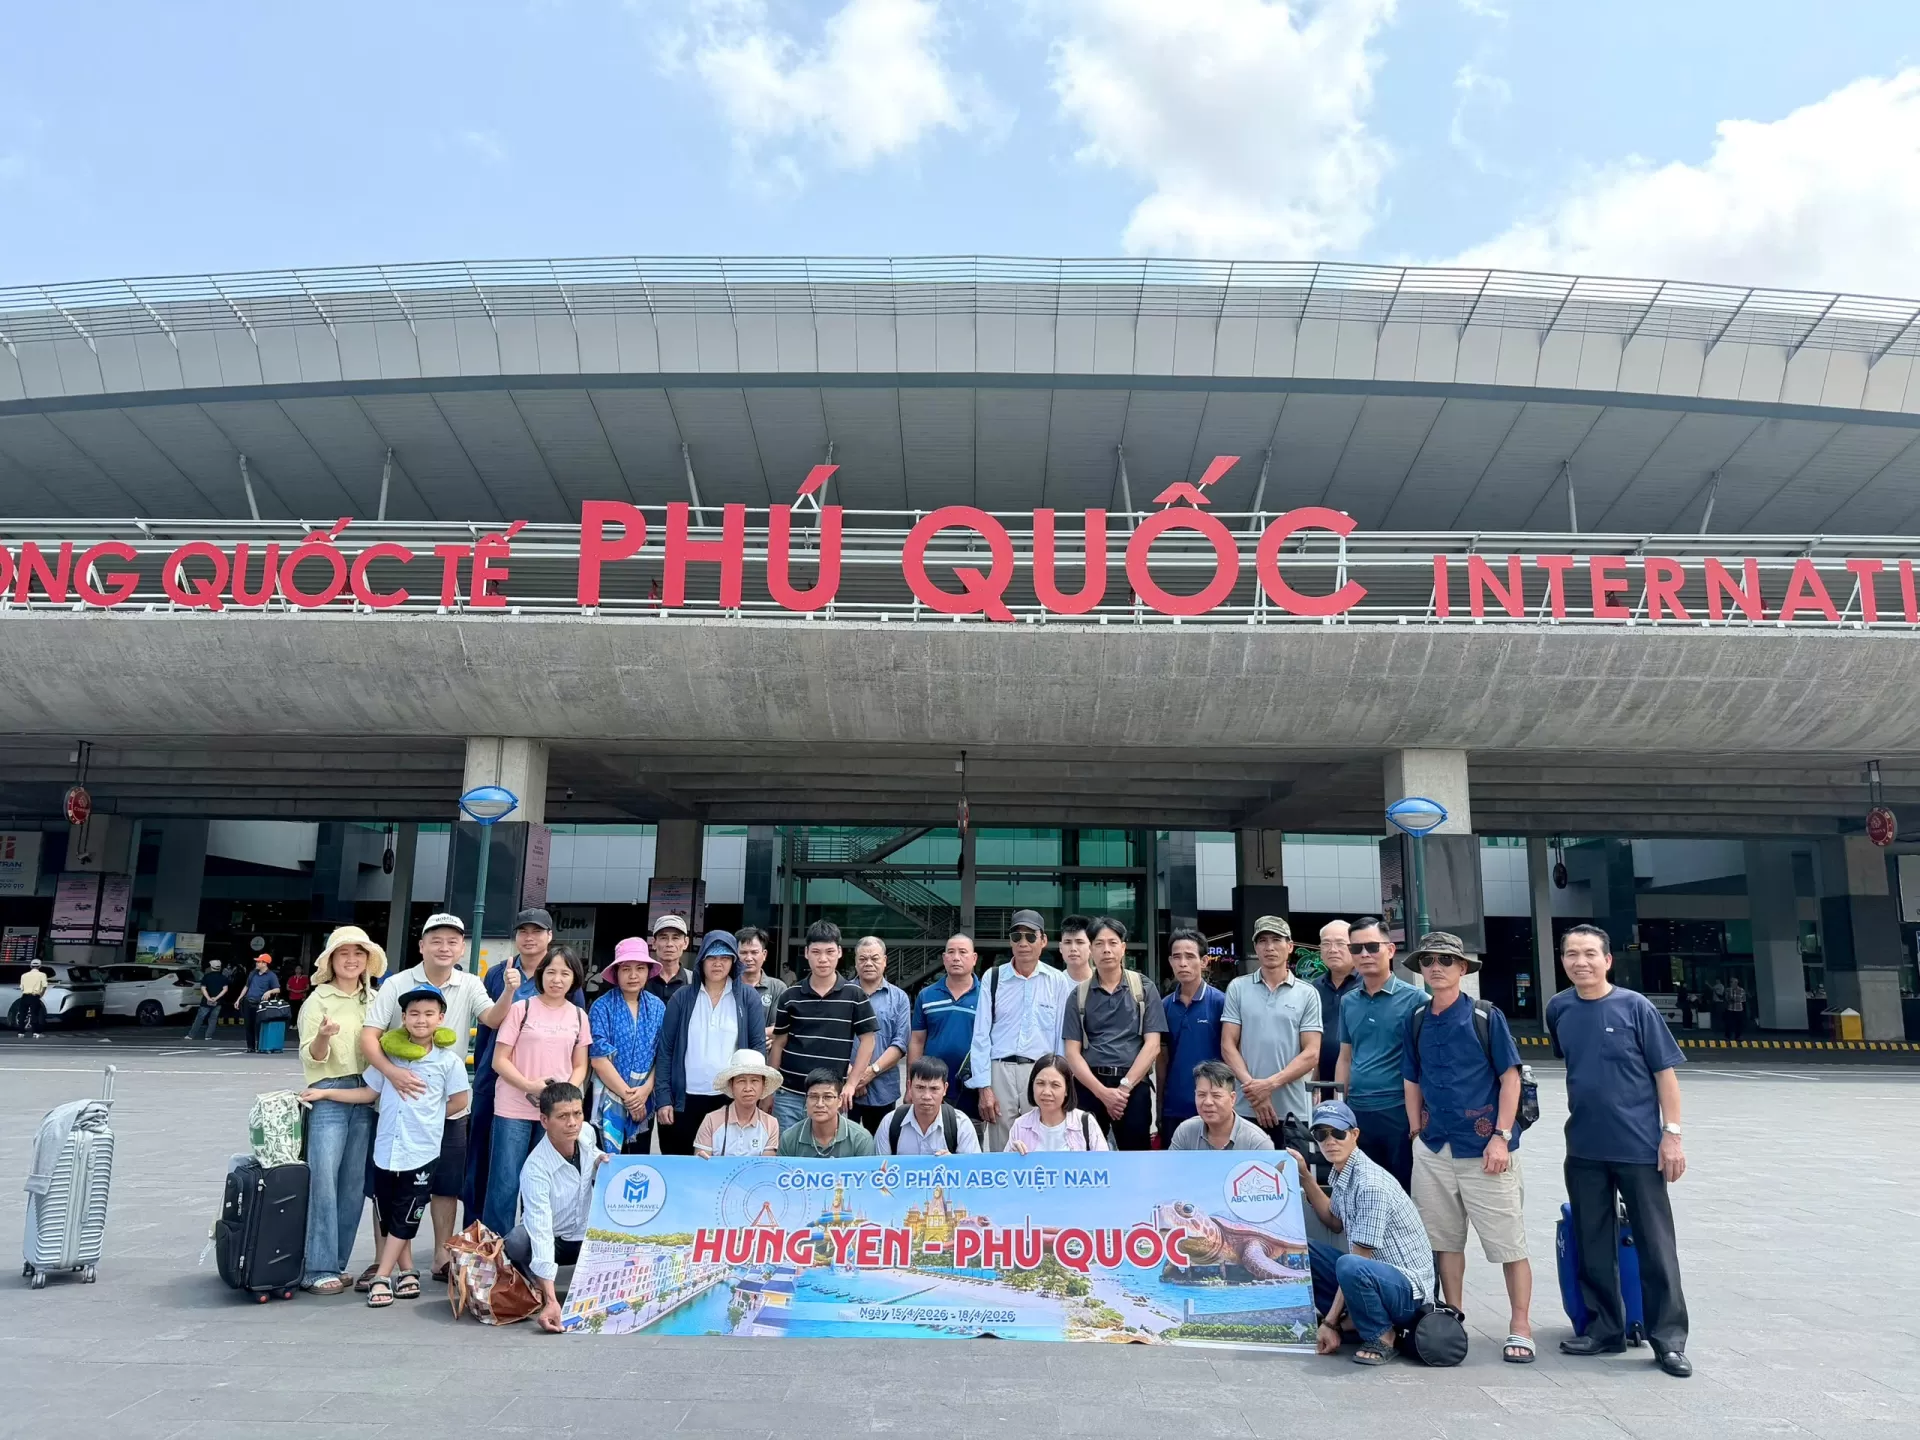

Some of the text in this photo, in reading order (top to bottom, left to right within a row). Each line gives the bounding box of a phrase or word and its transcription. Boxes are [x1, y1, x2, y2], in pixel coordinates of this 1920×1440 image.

[0, 456, 1919, 624] NG QUỐC TẾ PHÚ QUỐC INTERNATI
[777, 1164, 1110, 1193] CÔNG TY CỔ PHẦN ABC VIỆT NAM
[1231, 1193, 1284, 1203] ABC VIETNAM
[692, 1227, 814, 1264] HƯNG
[831, 1222, 911, 1266] YÊN
[954, 1215, 1043, 1268] PHÚ
[1056, 1207, 1190, 1273] QUỐC
[860, 1307, 889, 1320] Ngày
[891, 1308, 948, 1321] 15/4/2026
[958, 1309, 1016, 1323] 18/4/2026
